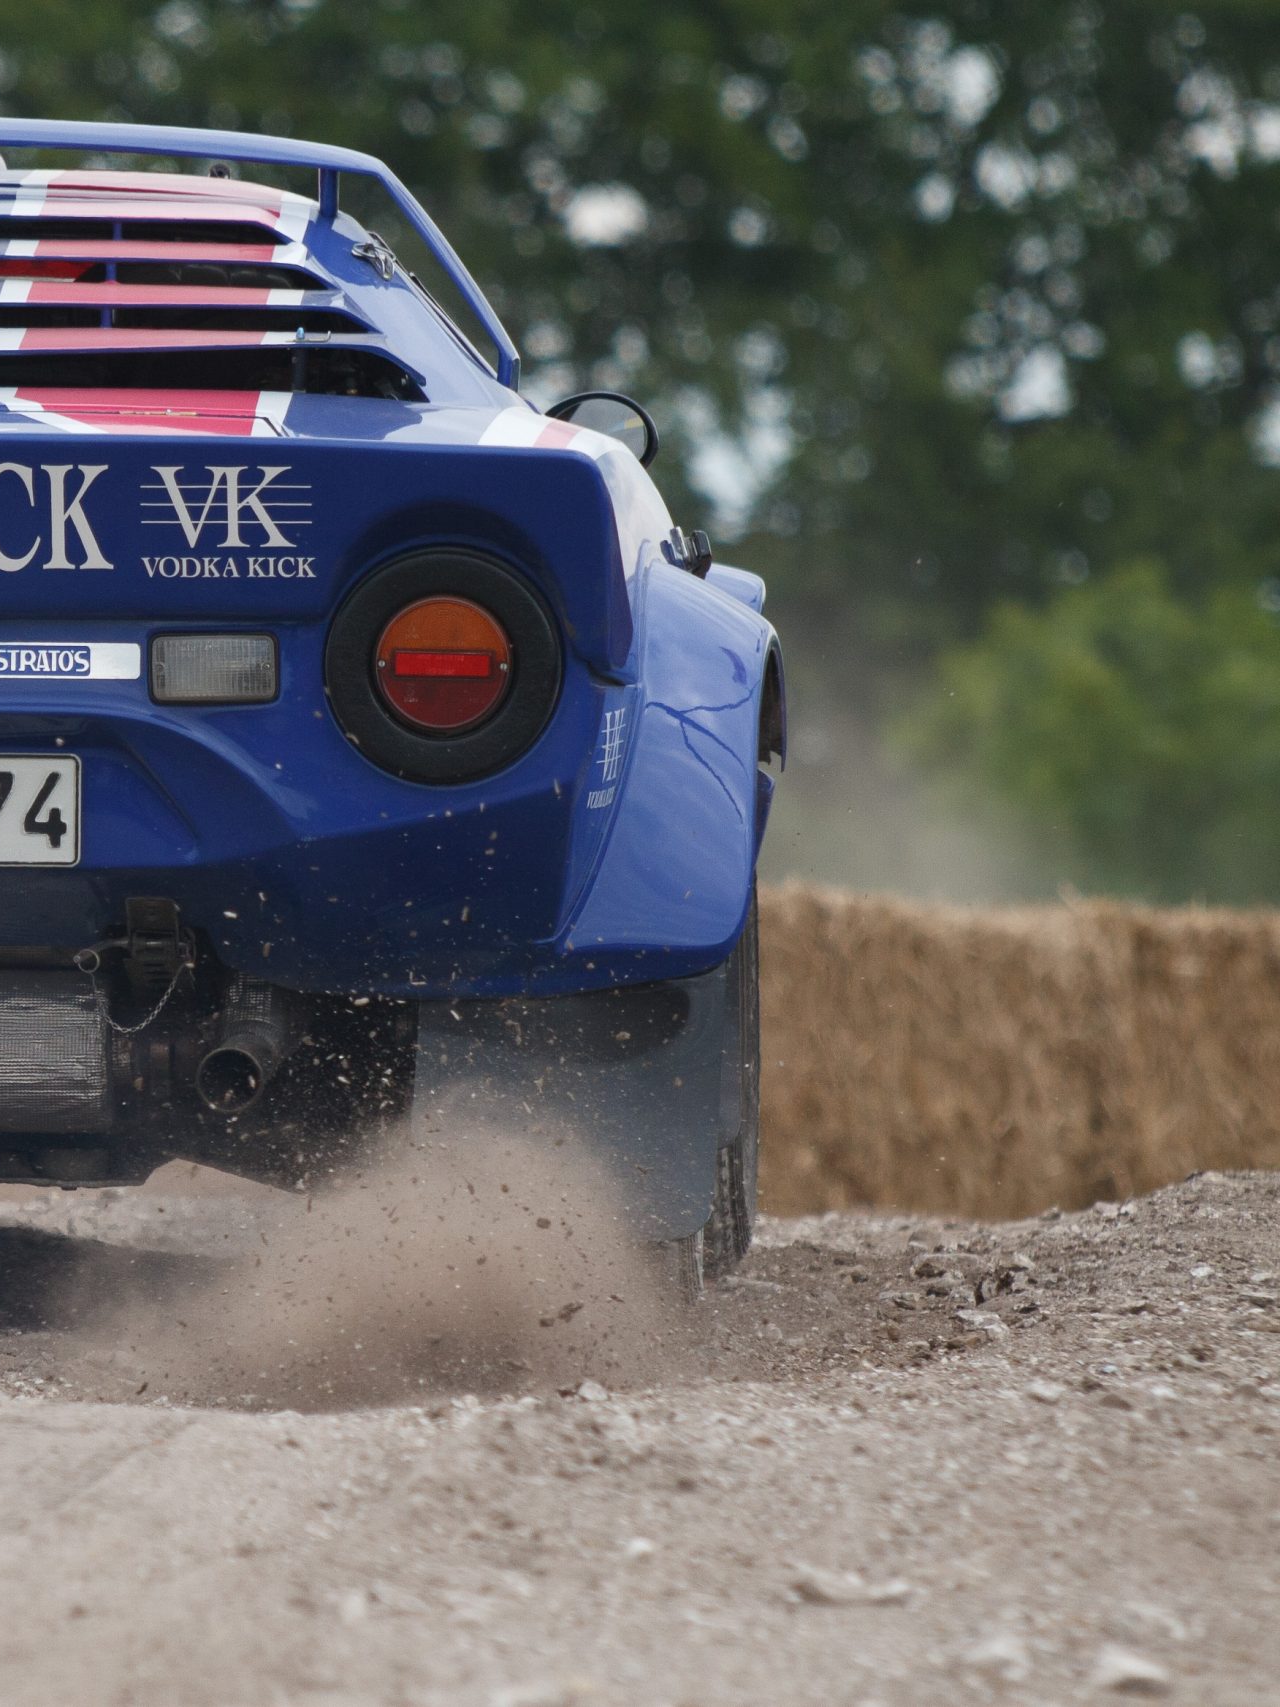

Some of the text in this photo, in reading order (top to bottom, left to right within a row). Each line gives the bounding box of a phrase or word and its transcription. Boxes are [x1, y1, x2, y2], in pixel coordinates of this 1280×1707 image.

[150, 466, 297, 548] VK
[141, 556, 317, 578] VODKA KICK
